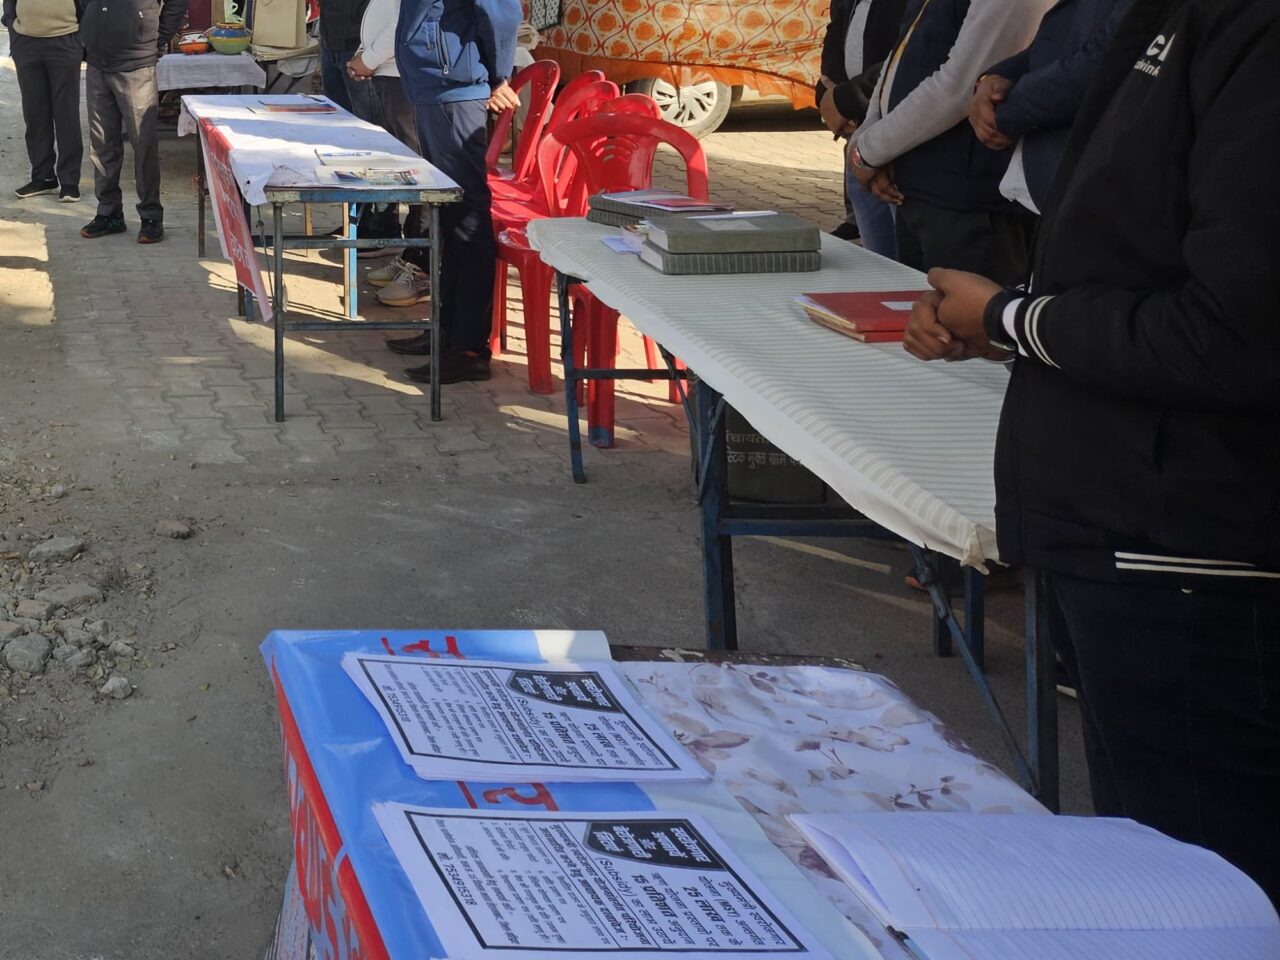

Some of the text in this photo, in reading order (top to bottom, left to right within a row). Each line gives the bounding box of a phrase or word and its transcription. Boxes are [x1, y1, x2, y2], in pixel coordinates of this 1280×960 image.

[509, 695, 545, 728] (Subsidy)
[443, 864, 477, 905] 7534915318
[594, 857, 638, 896] (Subsidy)
[640, 886, 678, 918] प्रतिशत
[694, 899, 726, 923] लाख
[749, 911, 787, 945] स्वरोजगार
